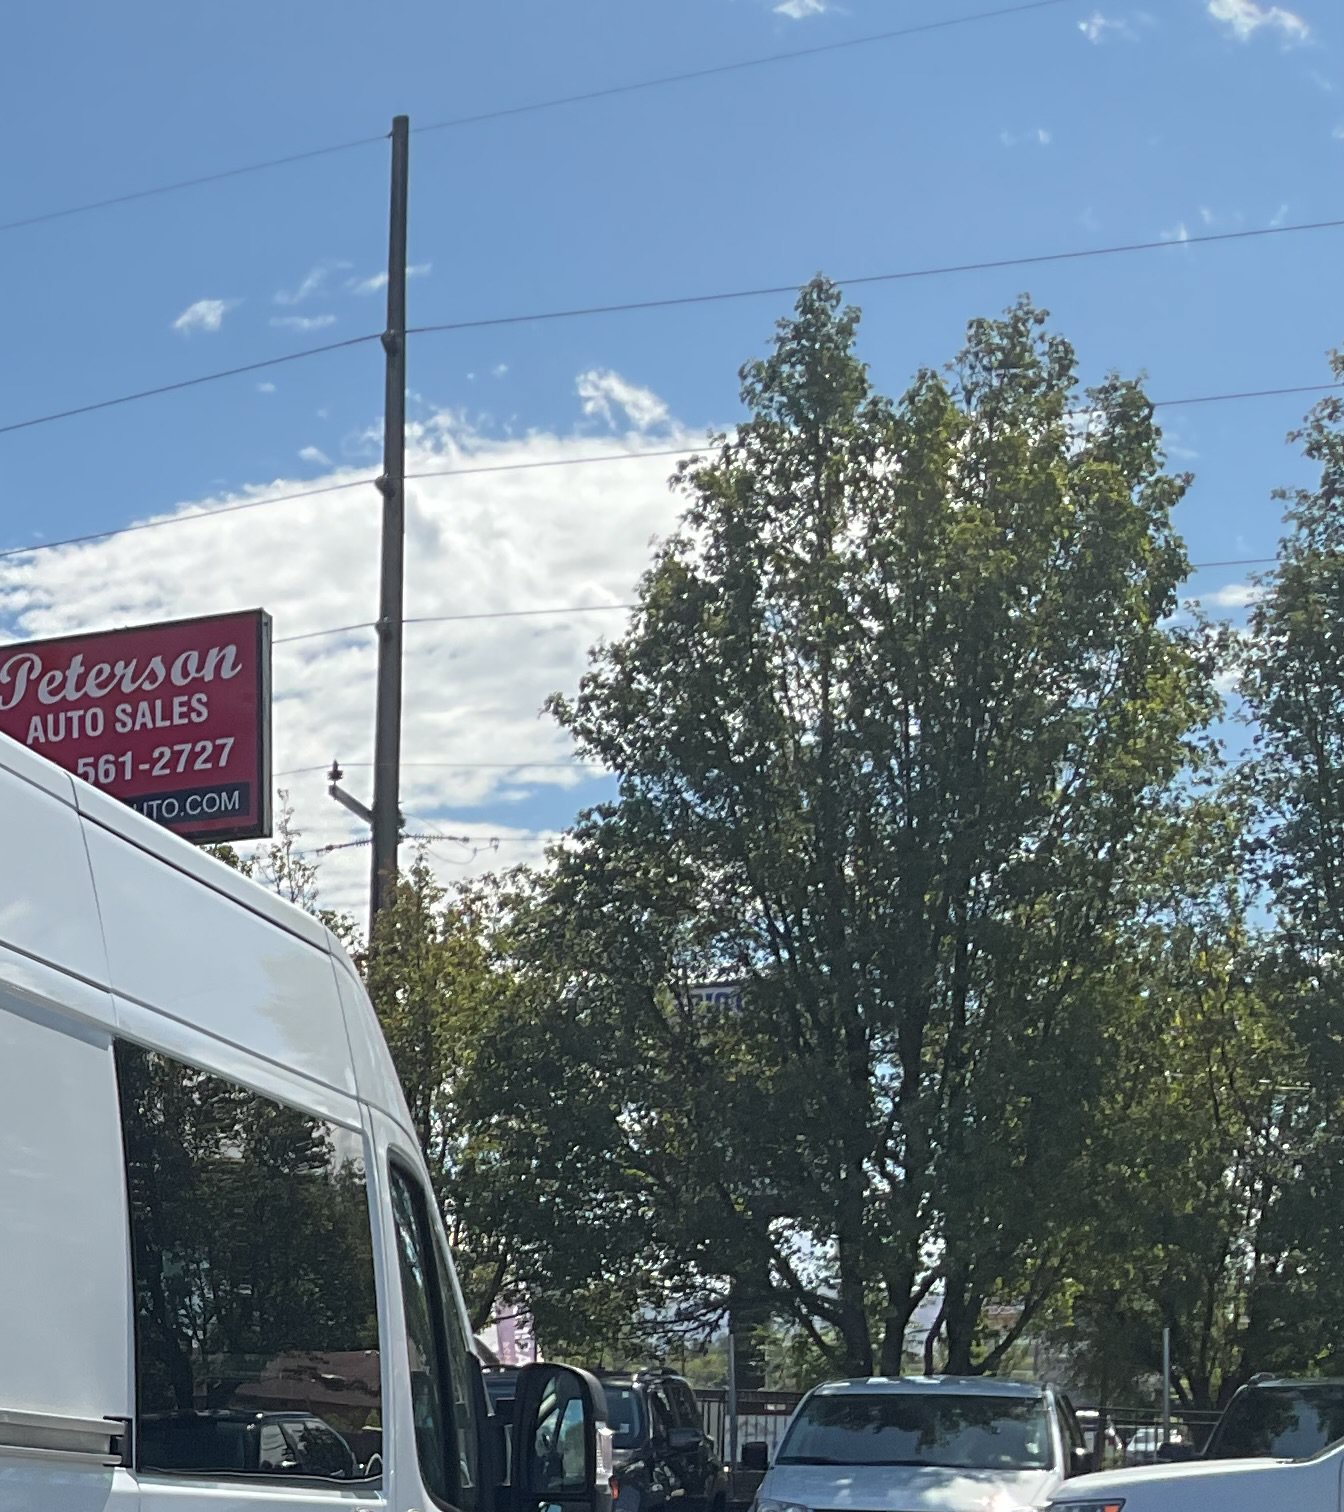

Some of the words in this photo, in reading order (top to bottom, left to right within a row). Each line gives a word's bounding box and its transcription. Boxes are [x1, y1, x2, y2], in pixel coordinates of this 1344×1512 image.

[26, 707, 105, 745] AUTO
[115, 693, 209, 734] SALES
[77, 737, 235, 785] 561-2727
